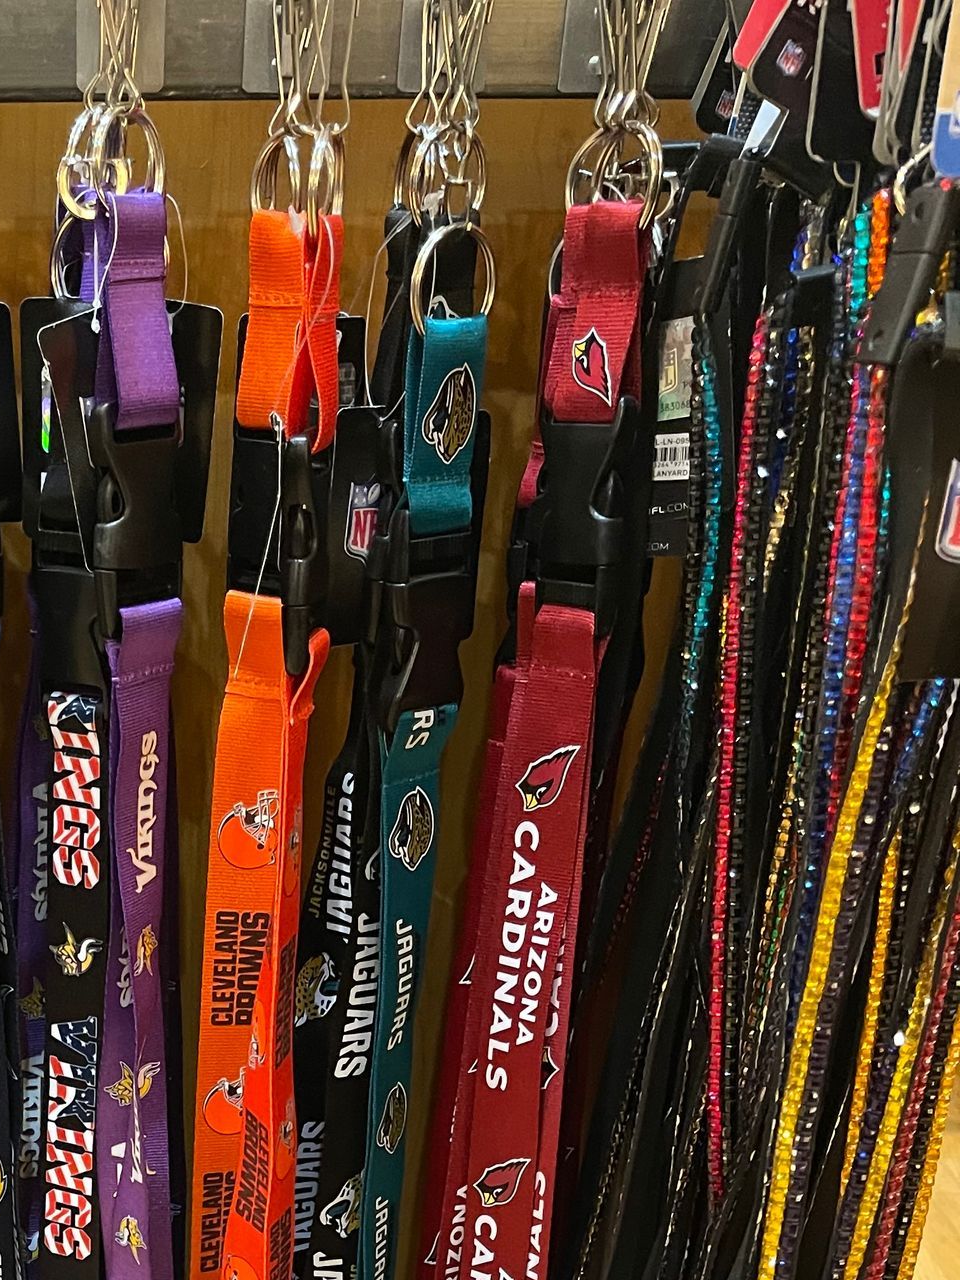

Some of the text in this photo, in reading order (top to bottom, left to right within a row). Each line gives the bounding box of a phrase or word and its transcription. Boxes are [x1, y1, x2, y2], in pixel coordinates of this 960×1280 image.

[311, 784, 337, 919] JACKSONVILLE
[211, 911, 239, 1026] CLEVELAND
[334, 912, 380, 1079] JAGUARS
[387, 918, 414, 1051] JAGUARS
[485, 820, 540, 1092] CARDINALS
[515, 881, 558, 1046] ARIZONA
[44, 1015, 98, 1260] VIKINGS
[235, 1107, 259, 1228] BROWNS
[251, 1118, 269, 1233] CLEVELAND
[200, 1172, 224, 1273] CLEVELAND
